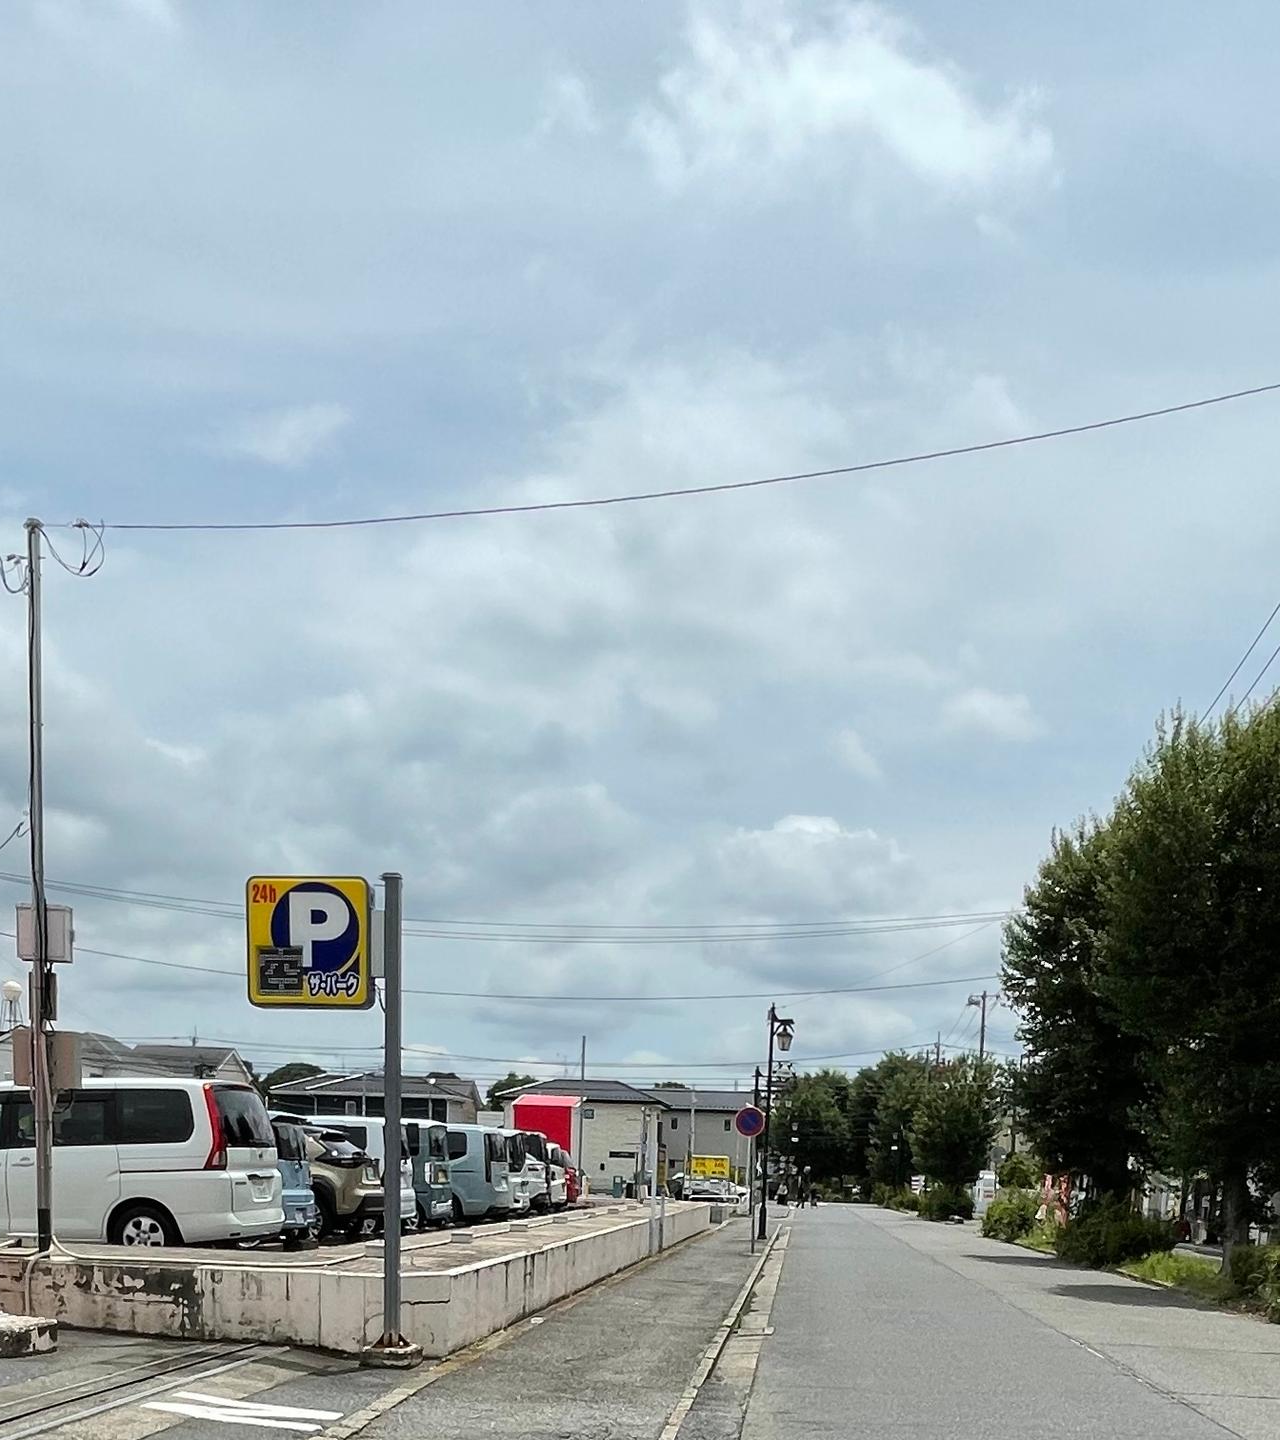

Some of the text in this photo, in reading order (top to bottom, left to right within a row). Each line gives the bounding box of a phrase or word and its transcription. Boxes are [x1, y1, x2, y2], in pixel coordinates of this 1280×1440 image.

[252, 883, 277, 903] 24h
[289, 891, 350, 968] P
[308, 973, 360, 997] ザ・パーク
